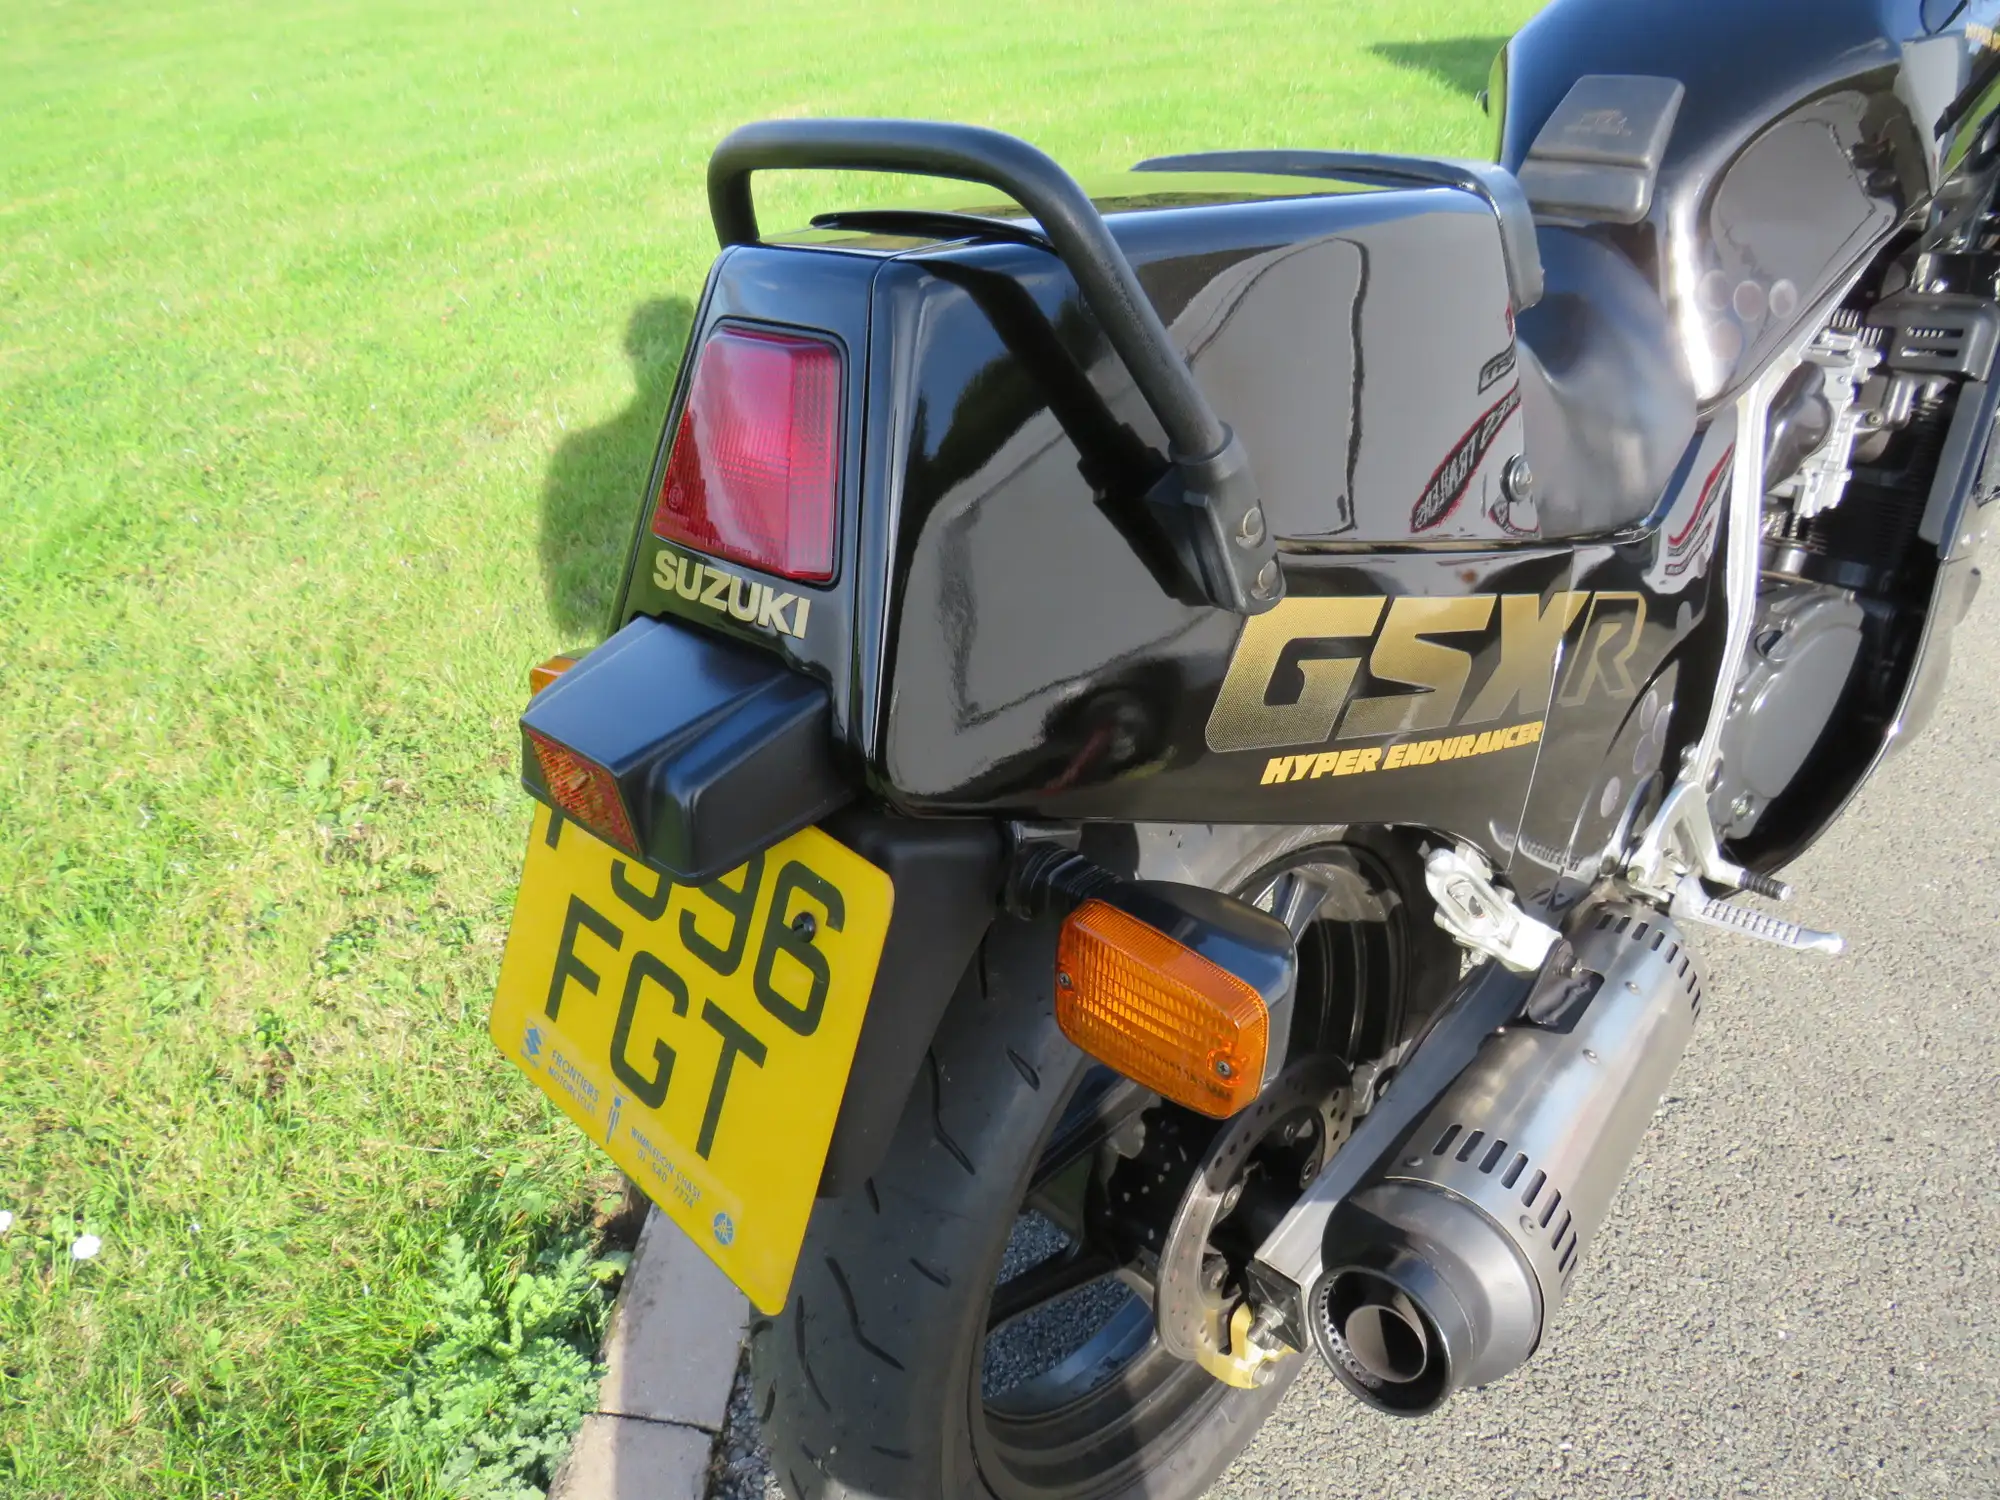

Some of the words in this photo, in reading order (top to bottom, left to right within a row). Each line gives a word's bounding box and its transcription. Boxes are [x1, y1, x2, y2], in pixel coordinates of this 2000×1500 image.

[653, 550, 811, 639] SUZUKI
[1260, 747, 1382, 785] HYPER
[1382, 720, 1544, 770] ENDURANCER
[545, 809, 845, 1037] 96
[544, 893, 768, 1161] FGT
[552, 1049, 599, 1102] FRONTIERS
